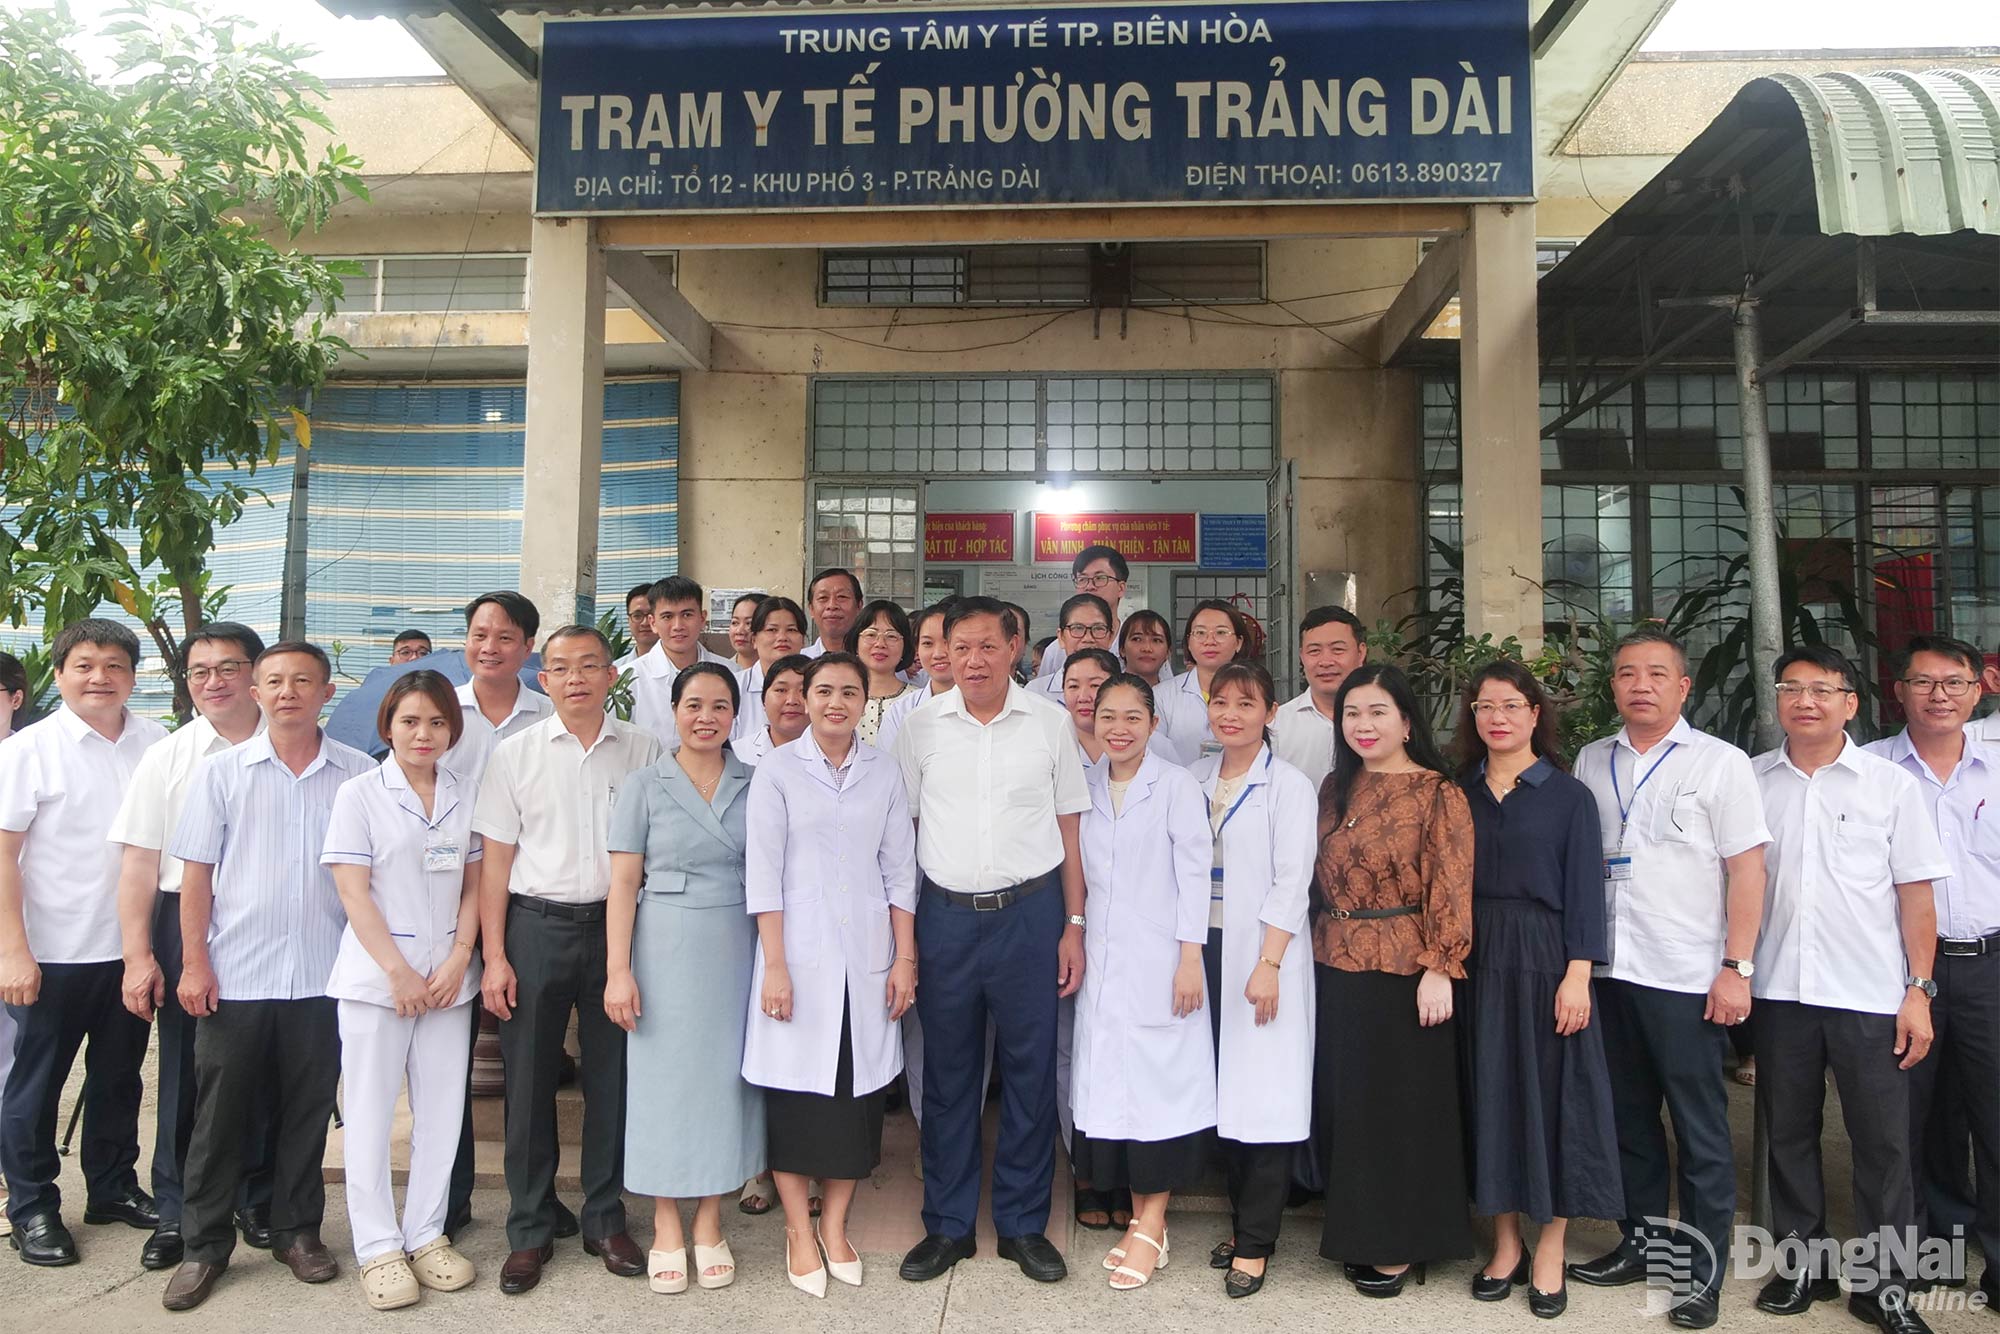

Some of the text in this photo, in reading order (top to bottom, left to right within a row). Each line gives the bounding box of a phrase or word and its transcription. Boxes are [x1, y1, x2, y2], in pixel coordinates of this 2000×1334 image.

[780, 12, 1274, 55] TRUNG TÂM Y TẾ TP. BIÊN HÒA
[561, 57, 1513, 167] TRẠM Y TẾ PHƯỜNG TRẢNG DÀI
[575, 177, 614, 203] ĐỊA
[619, 170, 664, 196] CHỈ:
[710, 175, 734, 195] 12
[754, 174, 802, 194] KHU
[807, 166, 856, 194] PHỐ
[863, 173, 875, 193] 3
[895, 164, 994, 191] P.TRẢNG
[1001, 164, 1041, 190] DÀI
[1186, 162, 1504, 192] ĐIỆN THOẠI: 0613.890327
[944, 537, 957, 558] TỰ
[966, 537, 987, 558] HỢP
[989, 535, 1008, 554] TÁC
[1060, 540, 1085, 554] MINH
[1118, 536, 1145, 558] THIỆN
[1152, 536, 1169, 558] TẬN
[1171, 536, 1190, 554] TÂM
[1030, 572, 1047, 581] LỊCH
[1048, 571, 1068, 580] CÔNG
